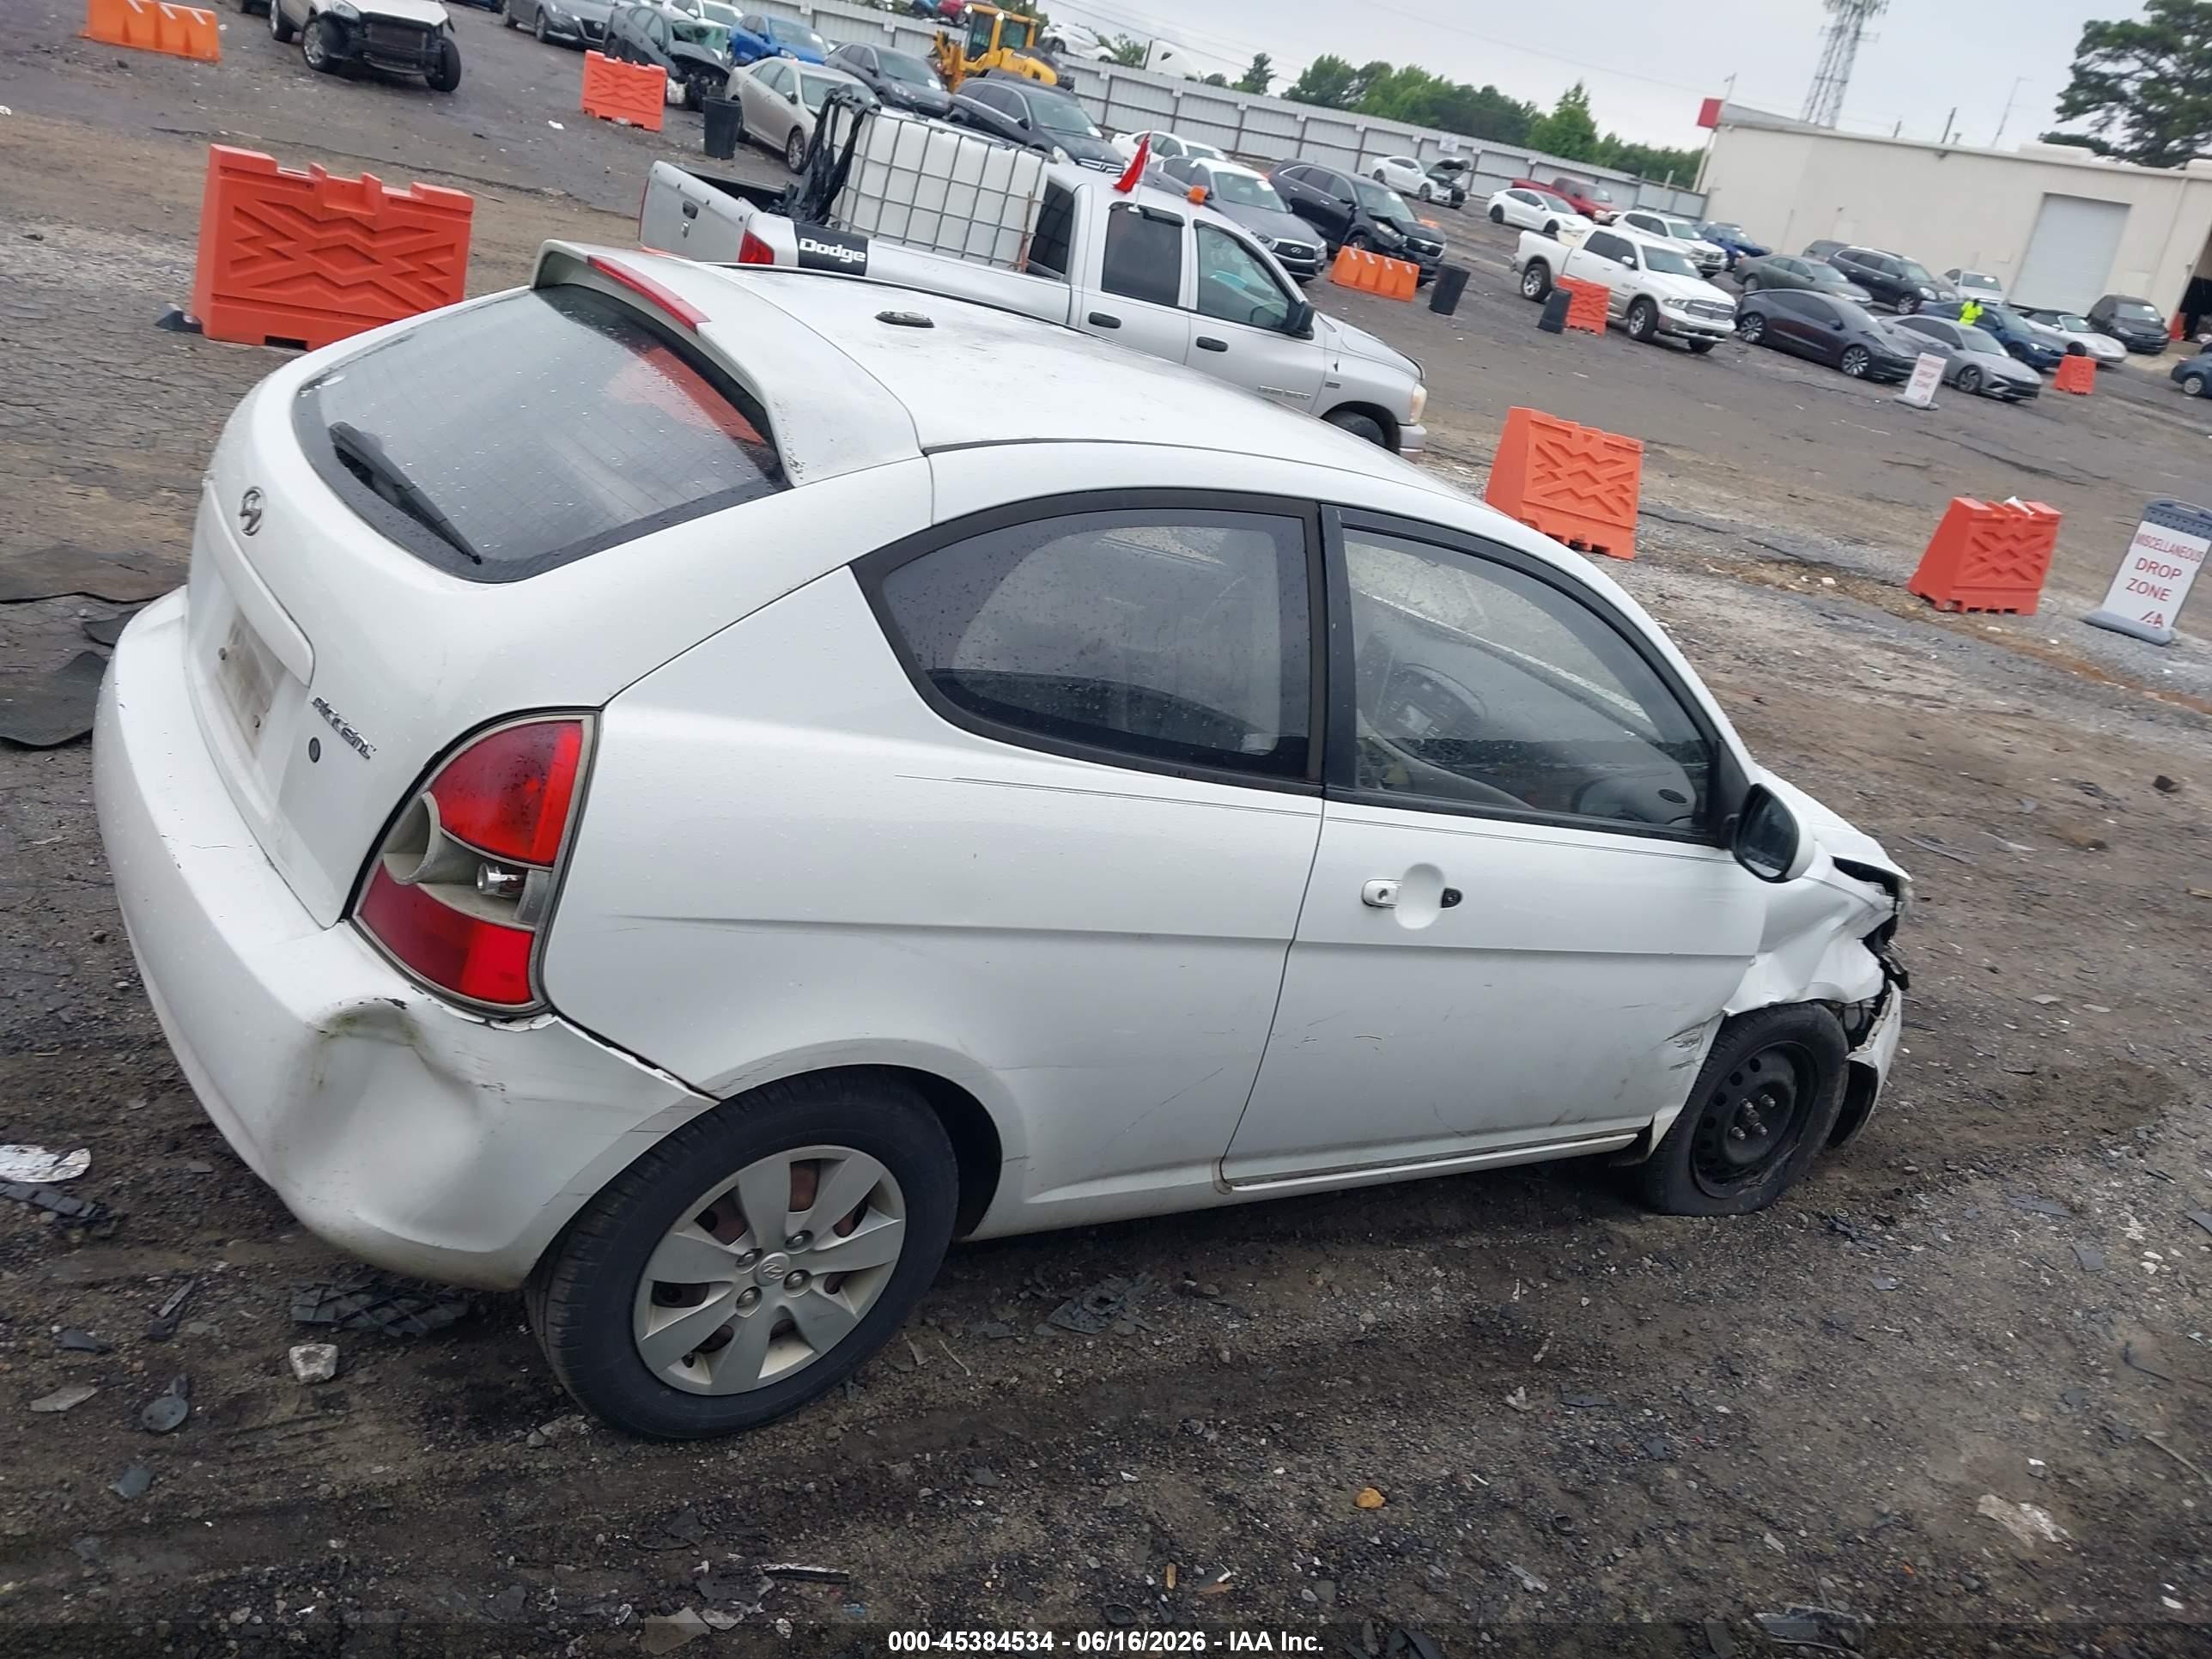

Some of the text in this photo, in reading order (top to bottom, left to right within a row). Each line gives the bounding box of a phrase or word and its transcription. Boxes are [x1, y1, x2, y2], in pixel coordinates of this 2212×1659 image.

[799, 237, 866, 264] Dodge
[2134, 532, 2205, 562] MISCELLANEOUS
[2135, 557, 2182, 580] DROP
[2125, 577, 2172, 602] ZONE
